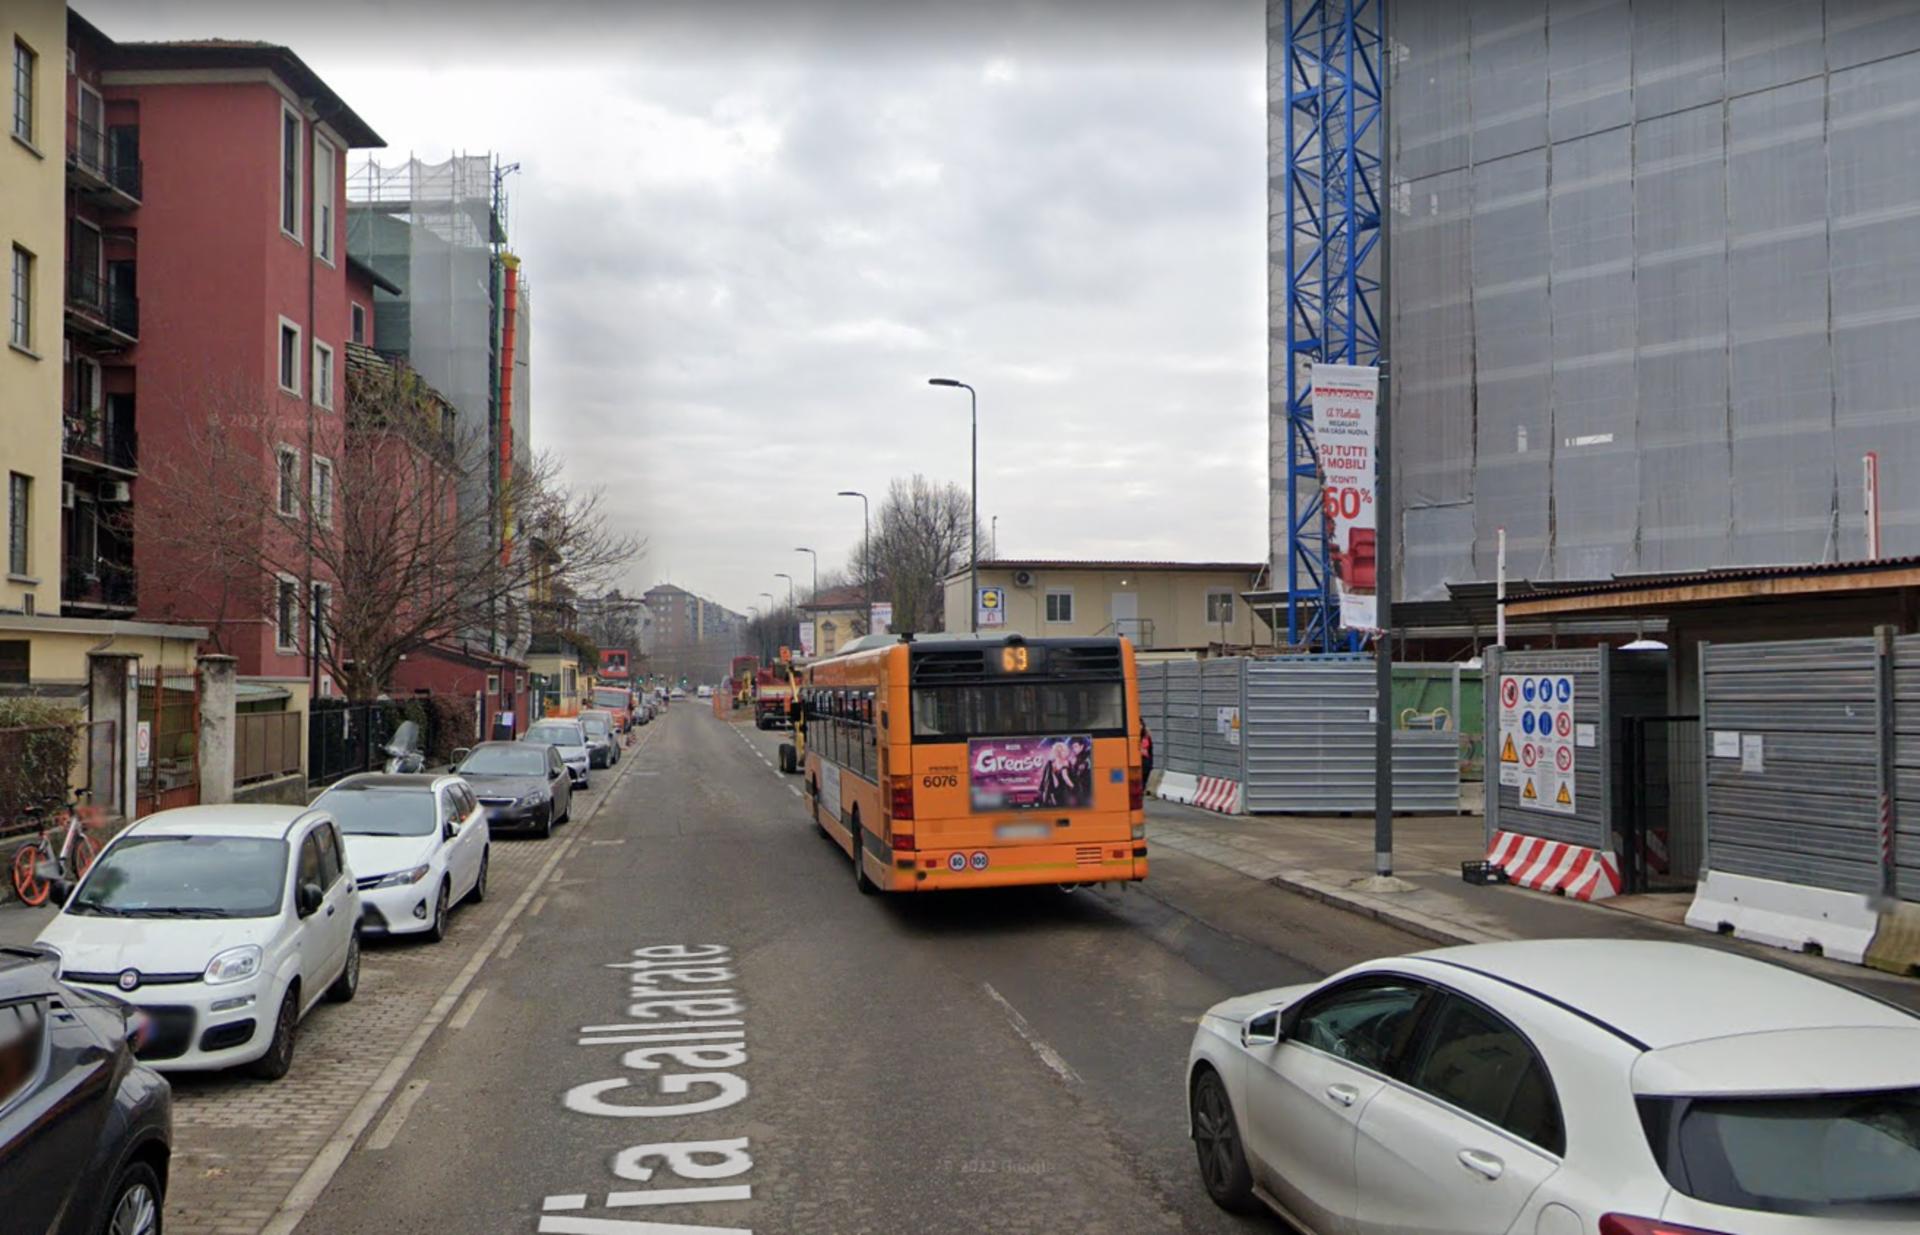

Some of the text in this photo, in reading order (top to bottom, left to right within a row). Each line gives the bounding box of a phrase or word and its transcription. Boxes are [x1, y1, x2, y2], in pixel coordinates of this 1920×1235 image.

[1321, 444, 1367, 457] SU TUTTI
[1328, 458, 1366, 470] MOBILI
[1330, 475, 1357, 484] SCONTI
[976, 749, 1044, 773] Grease
[923, 775, 958, 788] 6076
[973, 856, 986, 866] 100
[565, 944, 749, 1117] Gallarate
